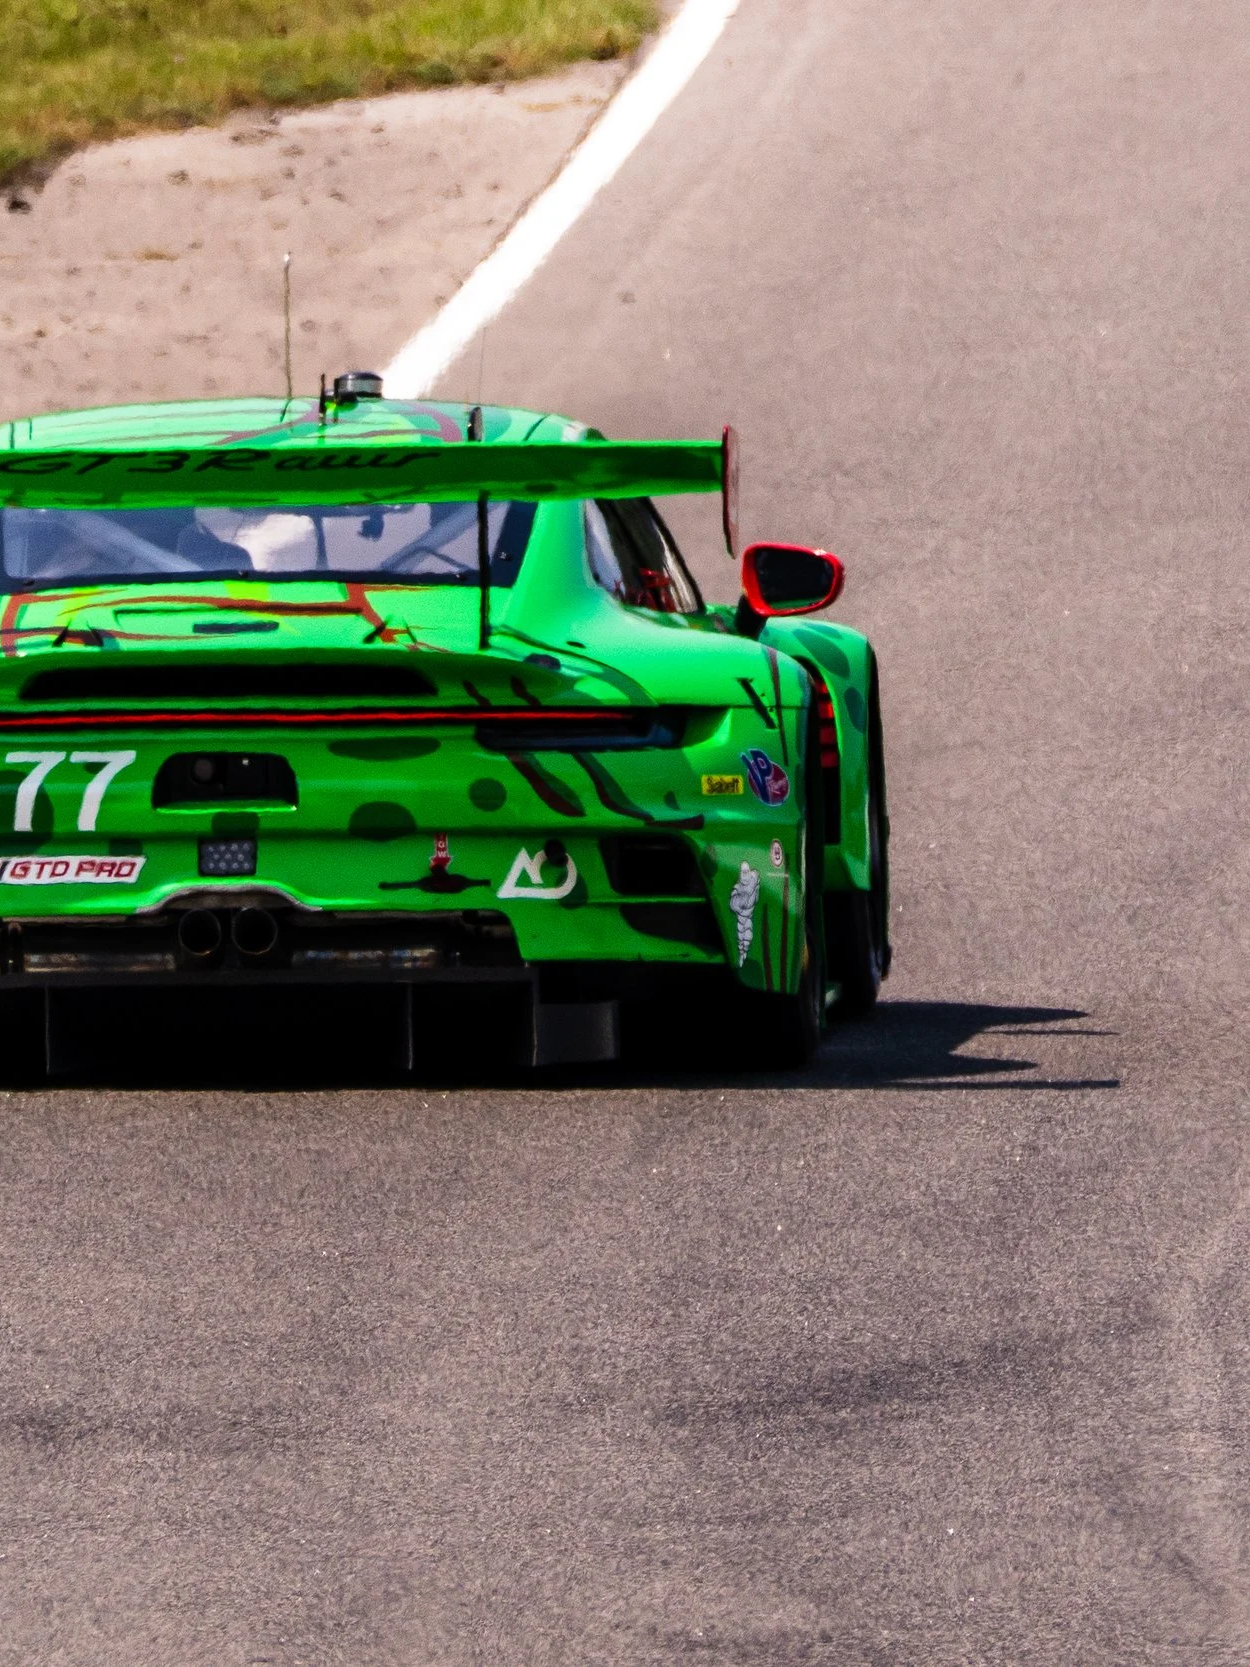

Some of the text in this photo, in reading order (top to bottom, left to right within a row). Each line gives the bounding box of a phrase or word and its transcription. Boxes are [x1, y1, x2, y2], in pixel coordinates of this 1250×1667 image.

[5, 750, 136, 832] 77
[10, 860, 137, 879] GTD PRO
